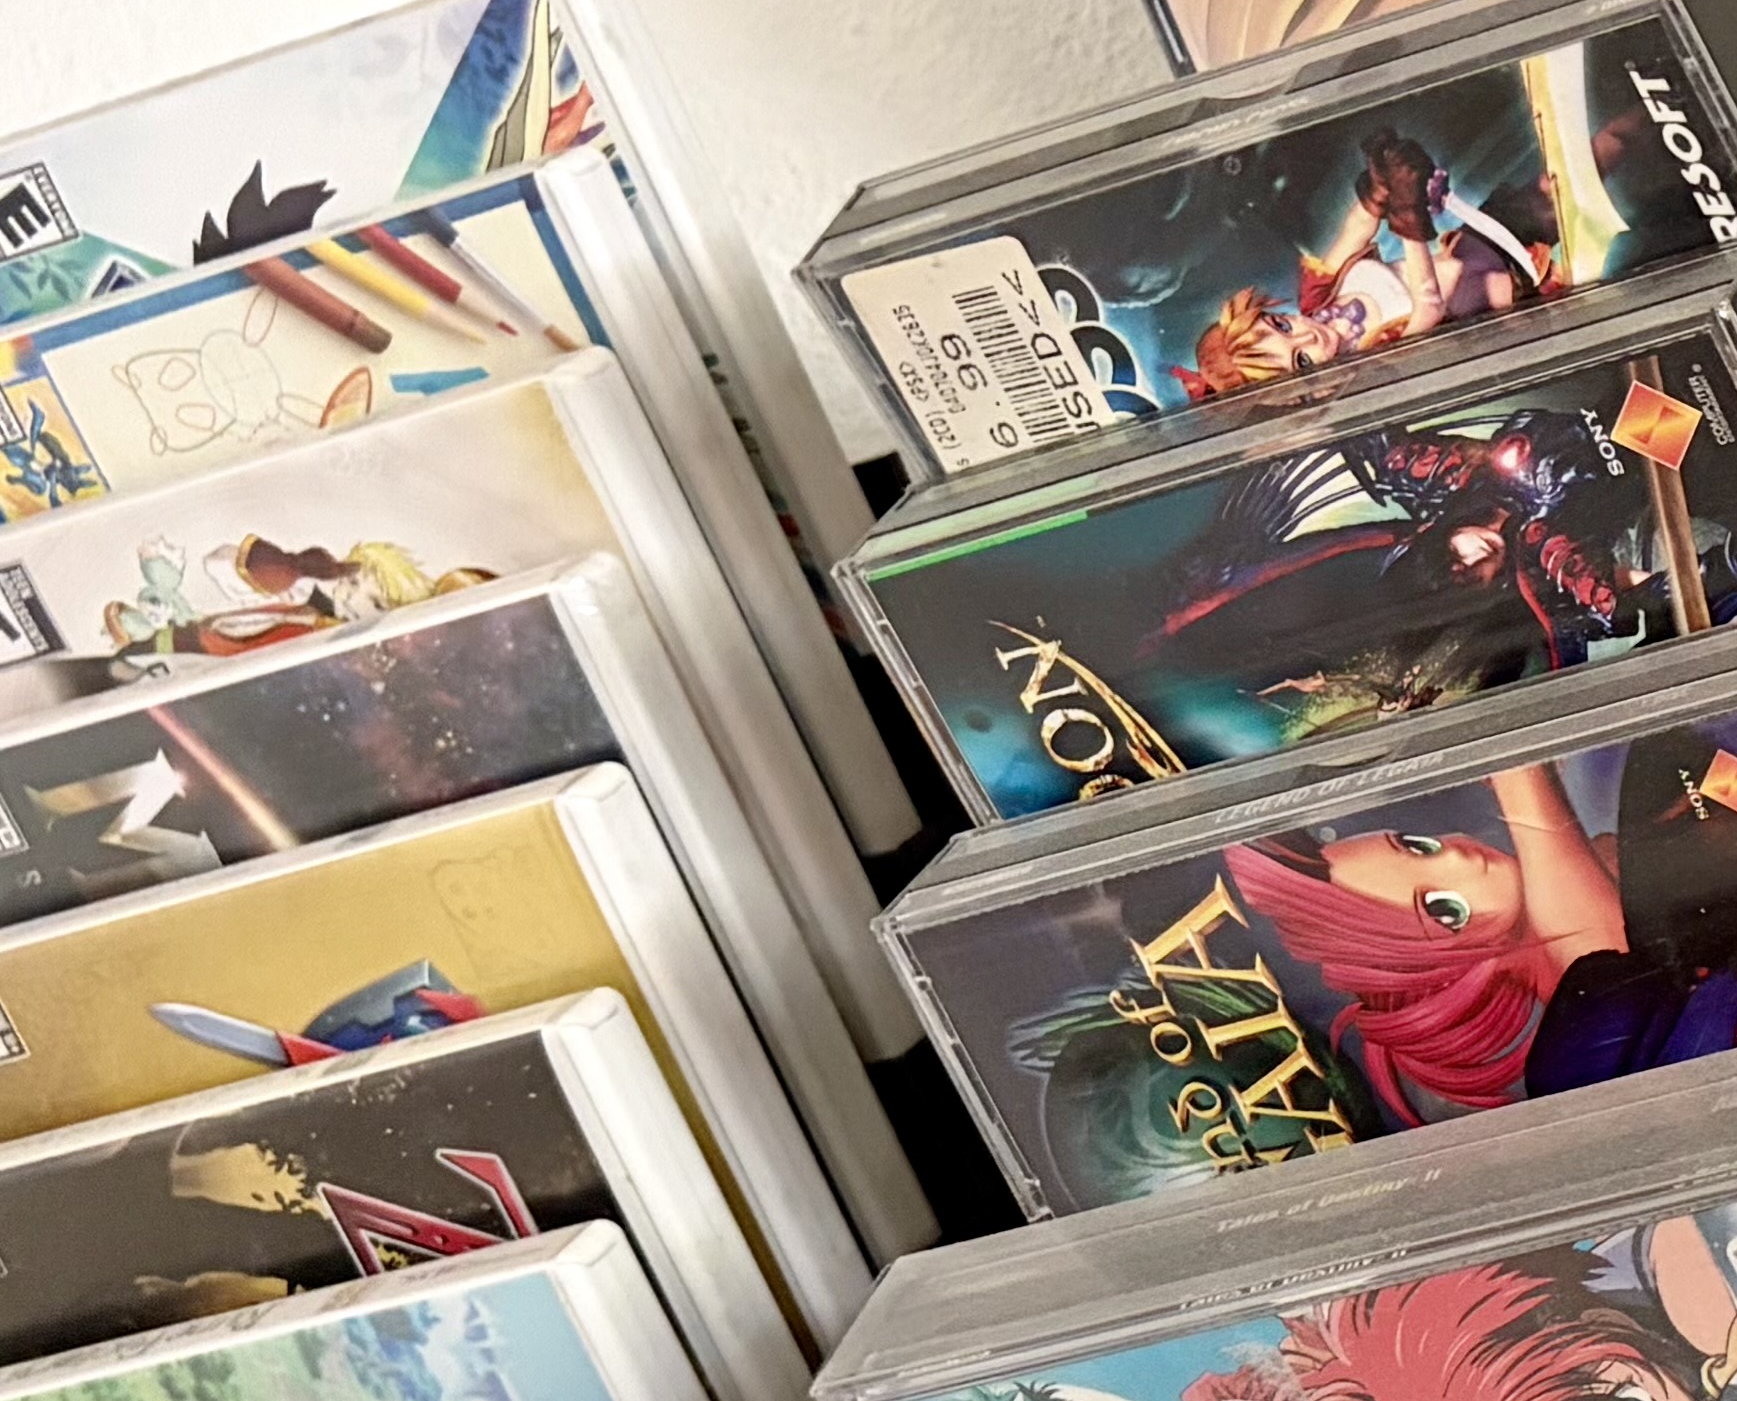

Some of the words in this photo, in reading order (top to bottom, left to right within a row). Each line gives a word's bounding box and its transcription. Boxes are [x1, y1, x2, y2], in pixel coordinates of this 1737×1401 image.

[1580, 407, 1625, 477] SONY
[1677, 768, 1710, 821] SONY
[1108, 989, 1193, 1066] of
